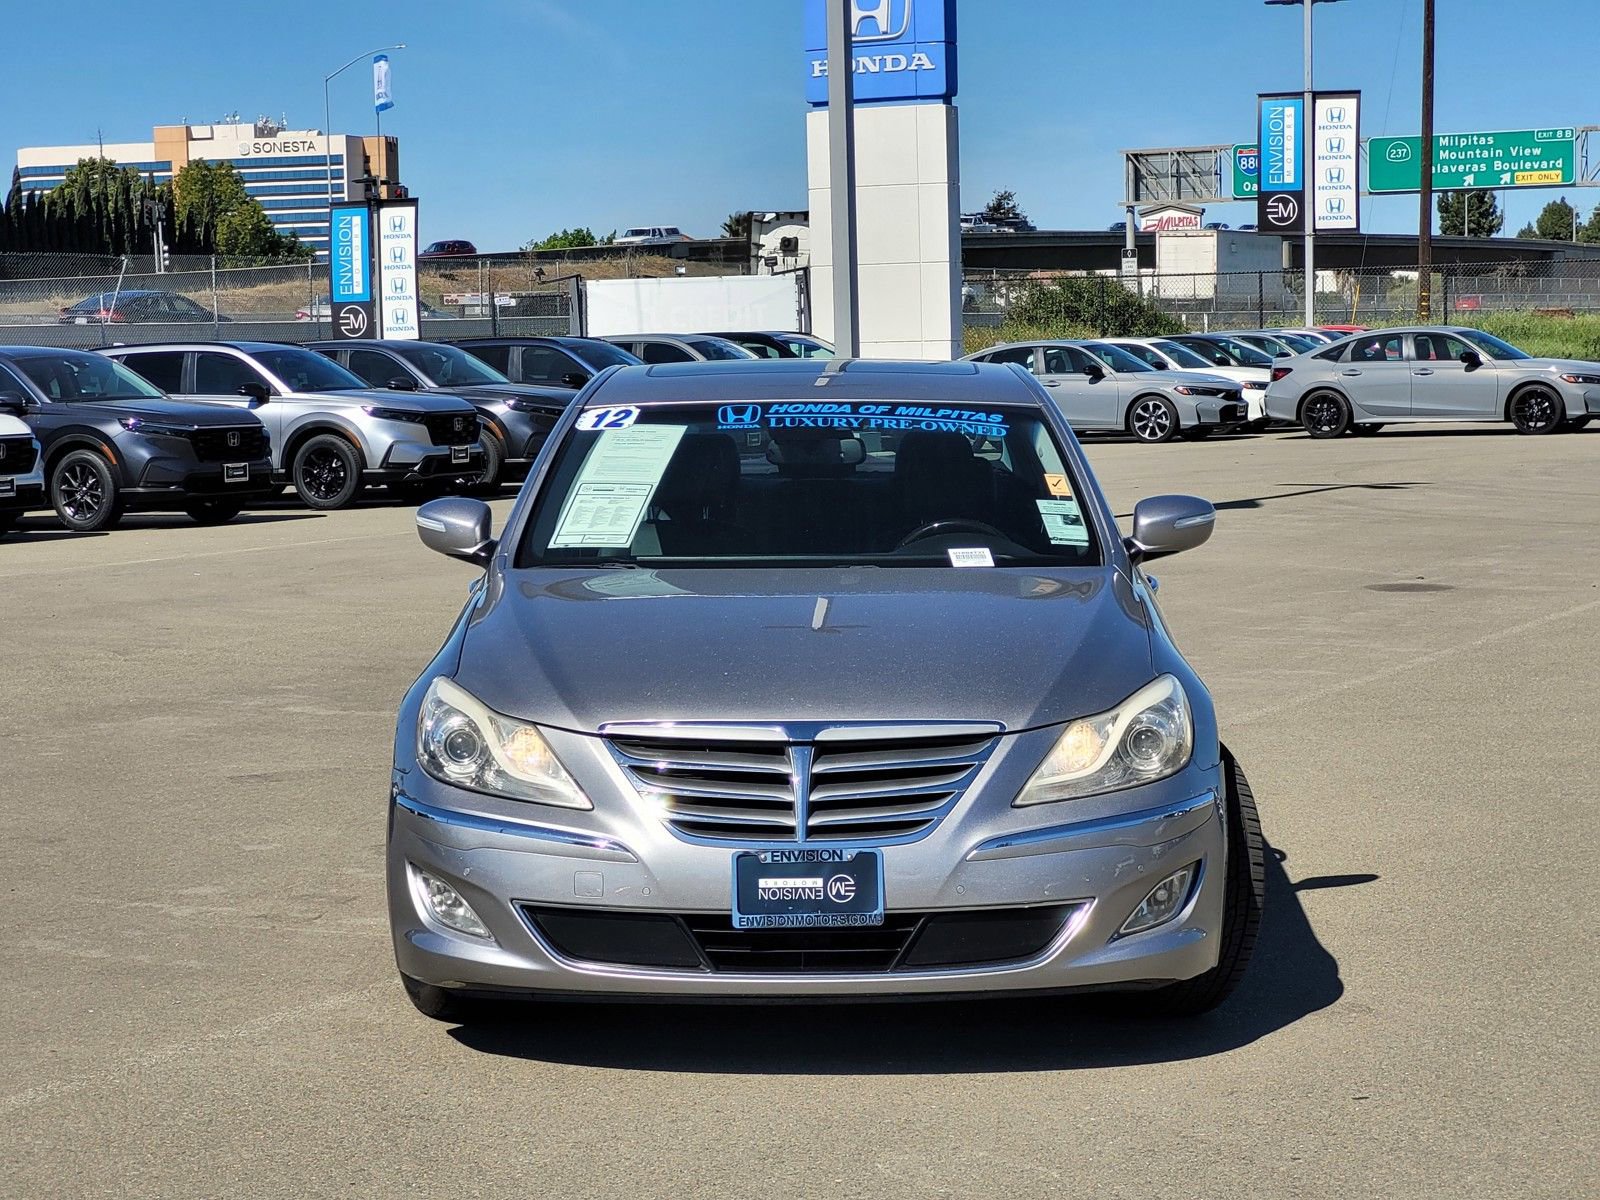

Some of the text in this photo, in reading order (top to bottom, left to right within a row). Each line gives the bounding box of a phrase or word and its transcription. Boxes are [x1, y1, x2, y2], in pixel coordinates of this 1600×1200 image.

[811, 52, 936, 77] HNDA
[1439, 135, 1494, 149] Milpitas
[1537, 131, 1553, 139] EXIT
[252, 140, 317, 154] SONESTA
[1269, 106, 1284, 184] ENVISION
[1389, 148, 1407, 158] 237
[1439, 146, 1542, 160] Mountain View
[1431, 157, 1563, 174] alaveras Boulevard
[1515, 173, 1561, 182] EXIT ONLY
[339, 216, 353, 295] ENVISION
[590, 409, 634, 428] 12
[768, 403, 1004, 423] HONDA OF MILPITAS
[768, 417, 1008, 437] LUXURY PRE-OWNED
[770, 850, 844, 862] ENVISION
[758, 887, 824, 900] ENVISION
